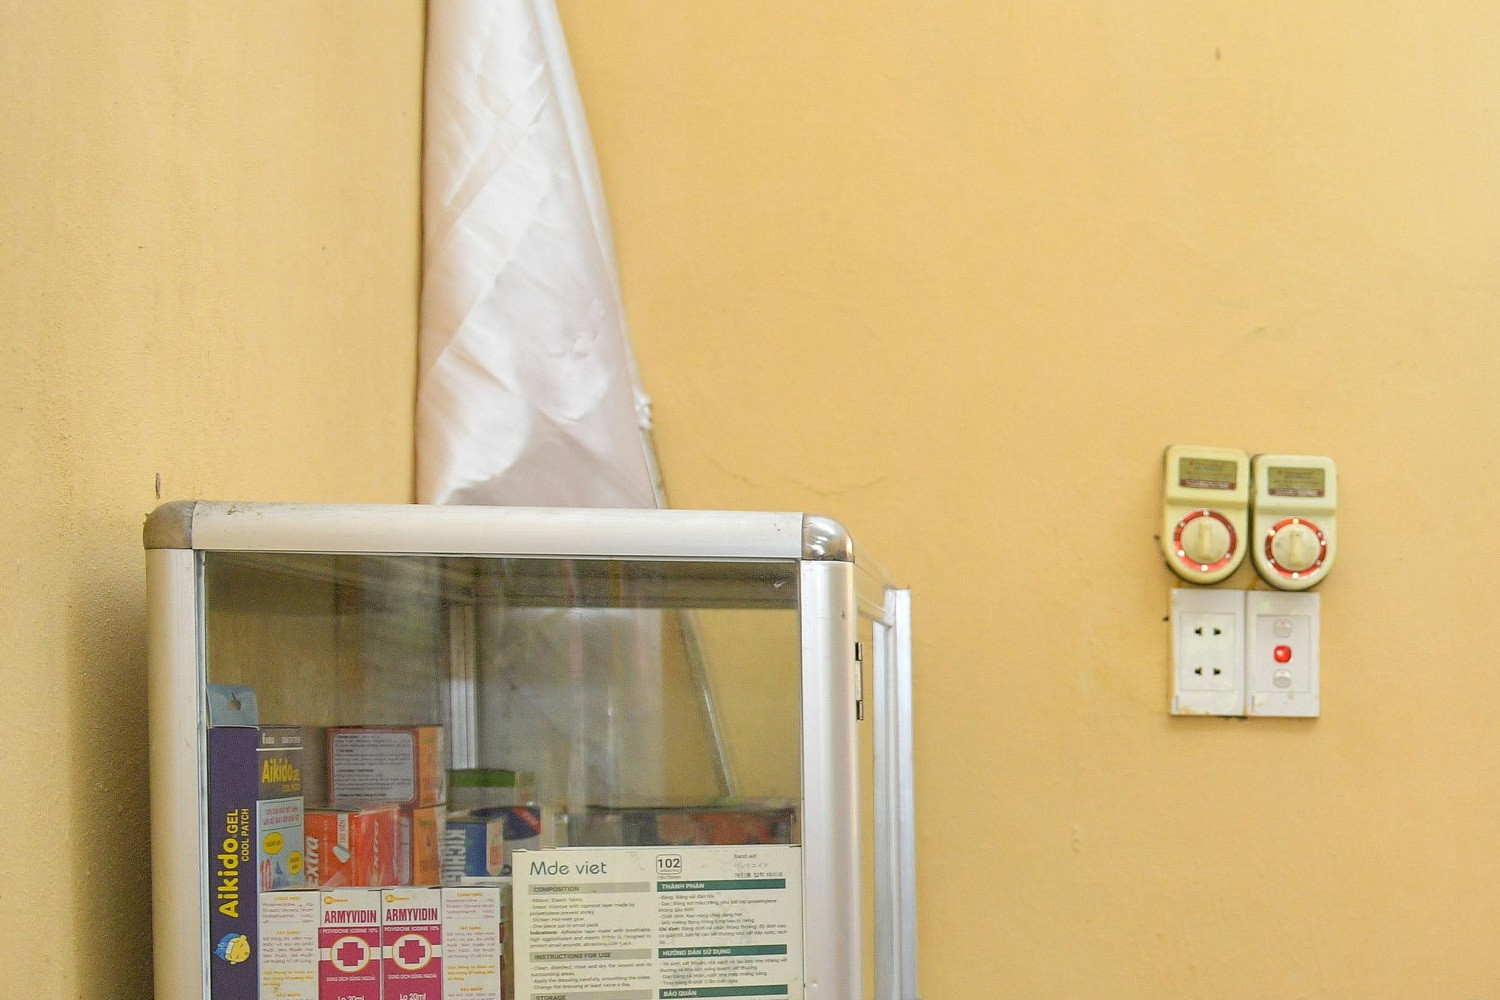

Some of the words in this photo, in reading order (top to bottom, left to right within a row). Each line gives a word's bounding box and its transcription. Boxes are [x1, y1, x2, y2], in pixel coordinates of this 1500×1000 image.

[227, 809, 239, 834] GEL
[241, 808, 250, 837] PATCH
[241, 838, 250, 862] COOL
[530, 860, 570, 876] Mde
[575, 860, 607, 875] viet
[657, 858, 681, 869] 102
[217, 838, 239, 918] Aikido
[533, 885, 580, 893] COMPOSITION
[324, 909, 377, 924] ARMYVIDIN
[385, 907, 438, 922] ARMYVIDIN
[409, 992, 427, 1000] 20ml
